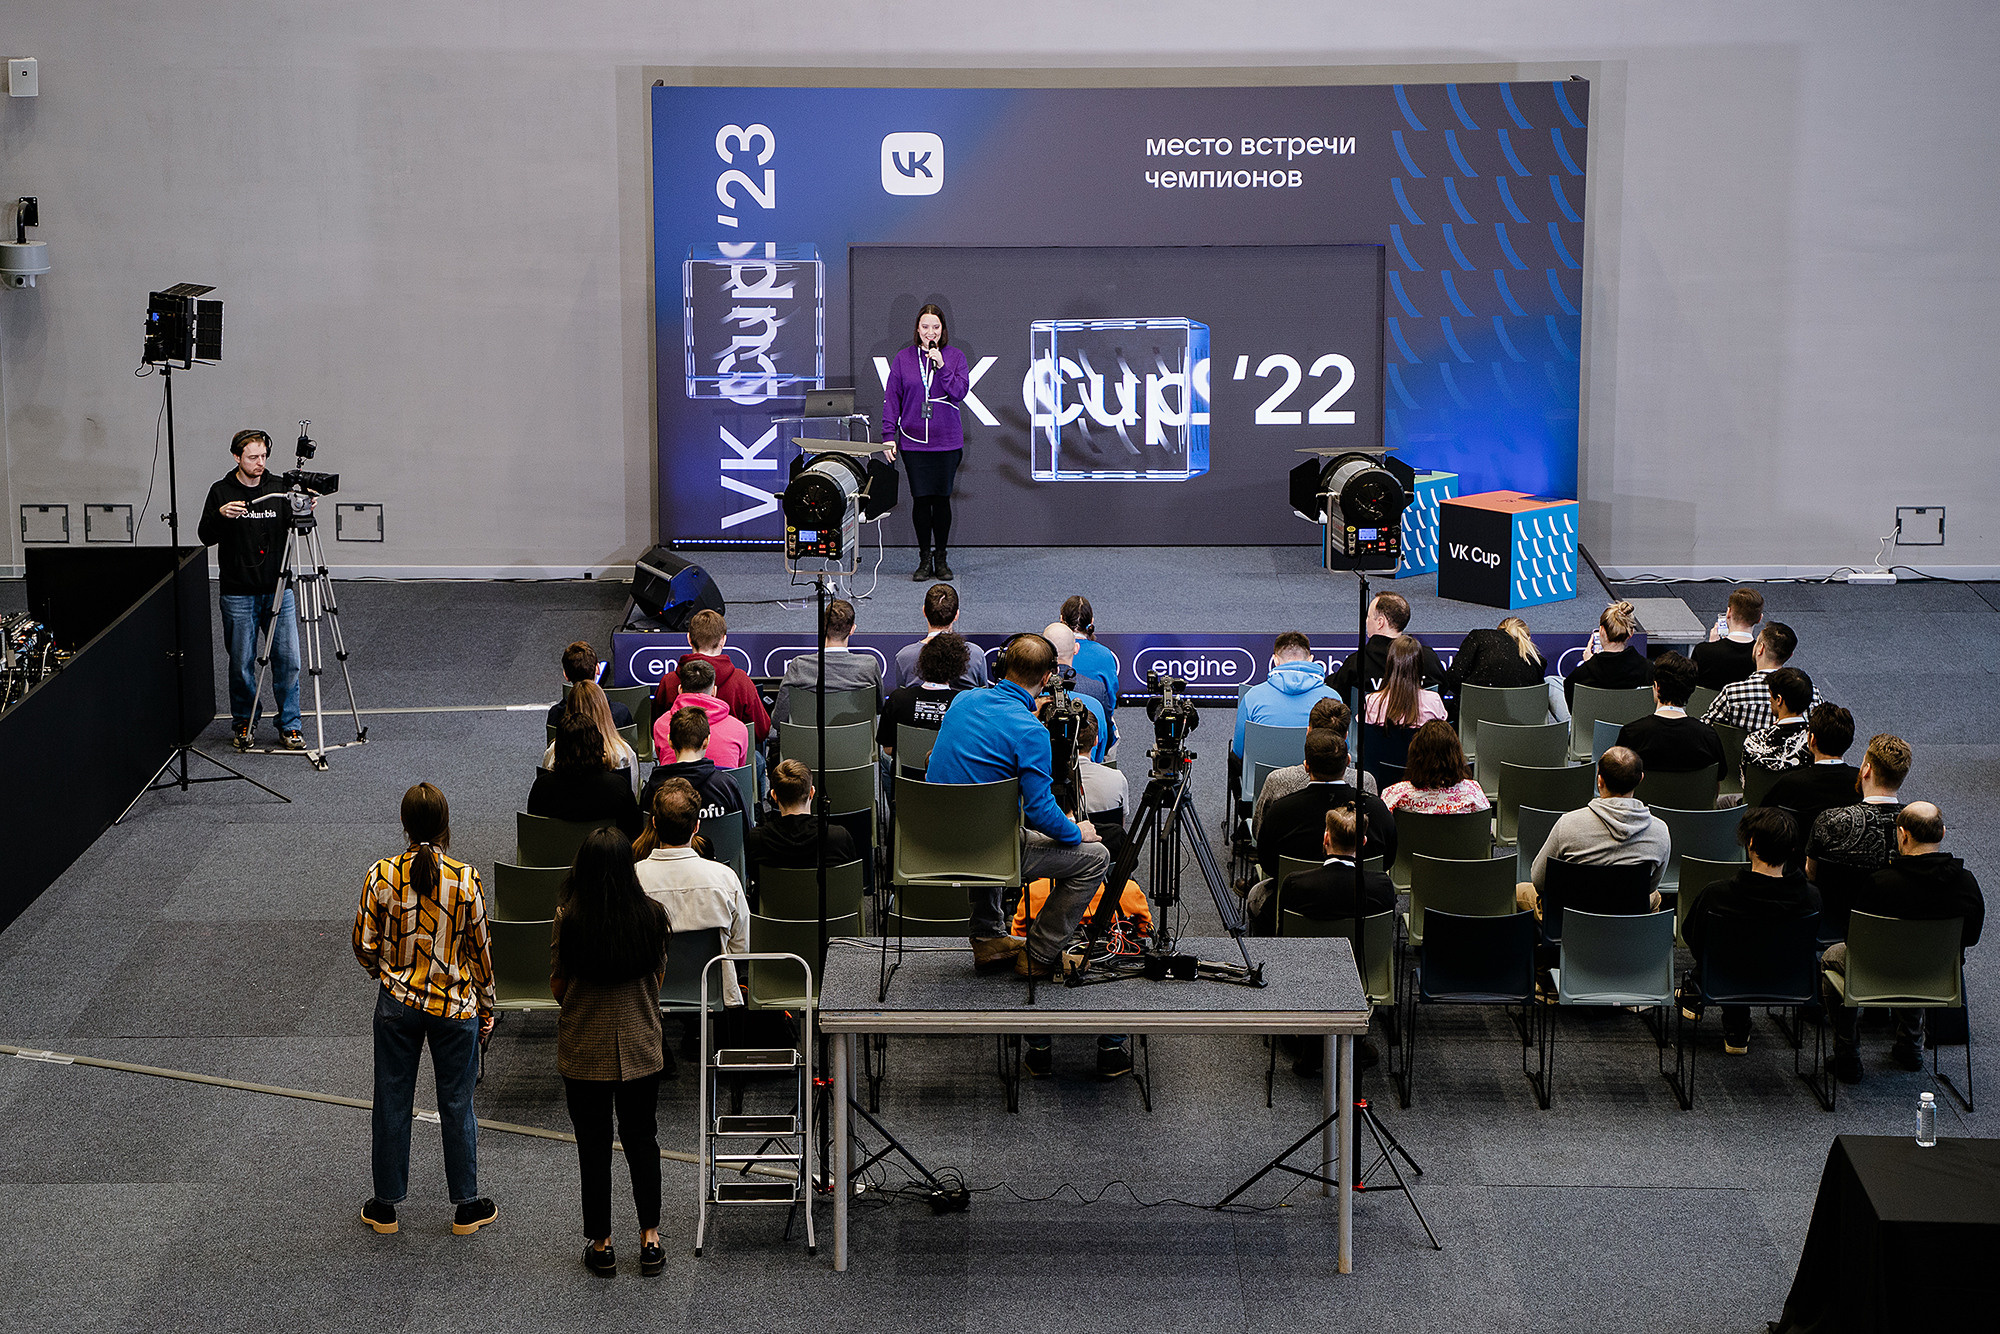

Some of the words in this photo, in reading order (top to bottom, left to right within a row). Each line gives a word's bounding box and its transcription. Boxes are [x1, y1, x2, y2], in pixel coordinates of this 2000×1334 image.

[1145, 137, 1233, 156] место
[1240, 136, 1356, 161] встречи
[715, 123, 776, 228] '23
[891, 151, 934, 178] VK
[1144, 169, 1303, 188] чемпионов
[1232, 353, 1356, 426] '22
[719, 425, 778, 530] VK
[1448, 542, 1469, 561] VK
[1471, 546, 1501, 569] Cup
[1151, 655, 1238, 681] engine
